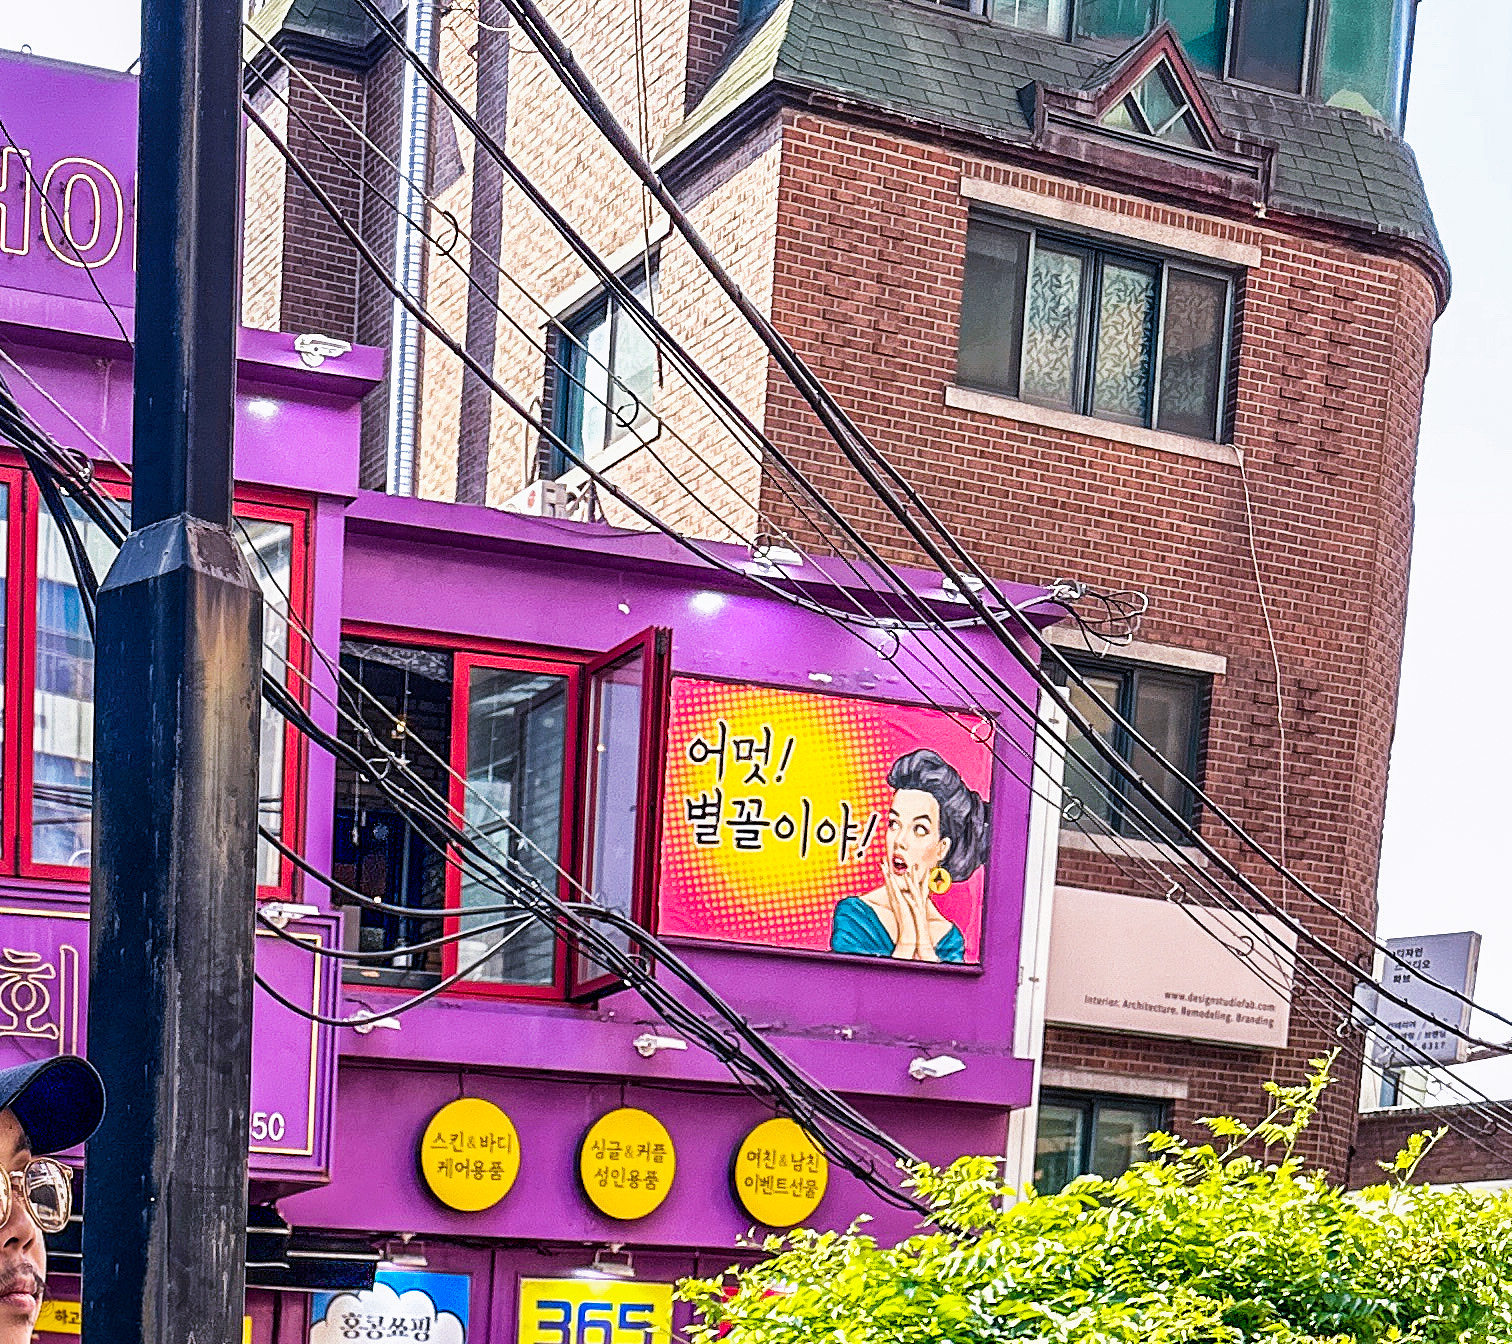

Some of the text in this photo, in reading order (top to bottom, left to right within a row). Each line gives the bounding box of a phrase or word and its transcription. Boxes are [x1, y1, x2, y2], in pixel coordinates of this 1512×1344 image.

[688, 720, 794, 784] 어멋!
[685, 788, 879, 862] 별꼴이야!
[437, 1157, 506, 1182] 케어용품
[593, 1166, 660, 1191] 성인용품
[743, 1174, 820, 1199] 이벤트선물
